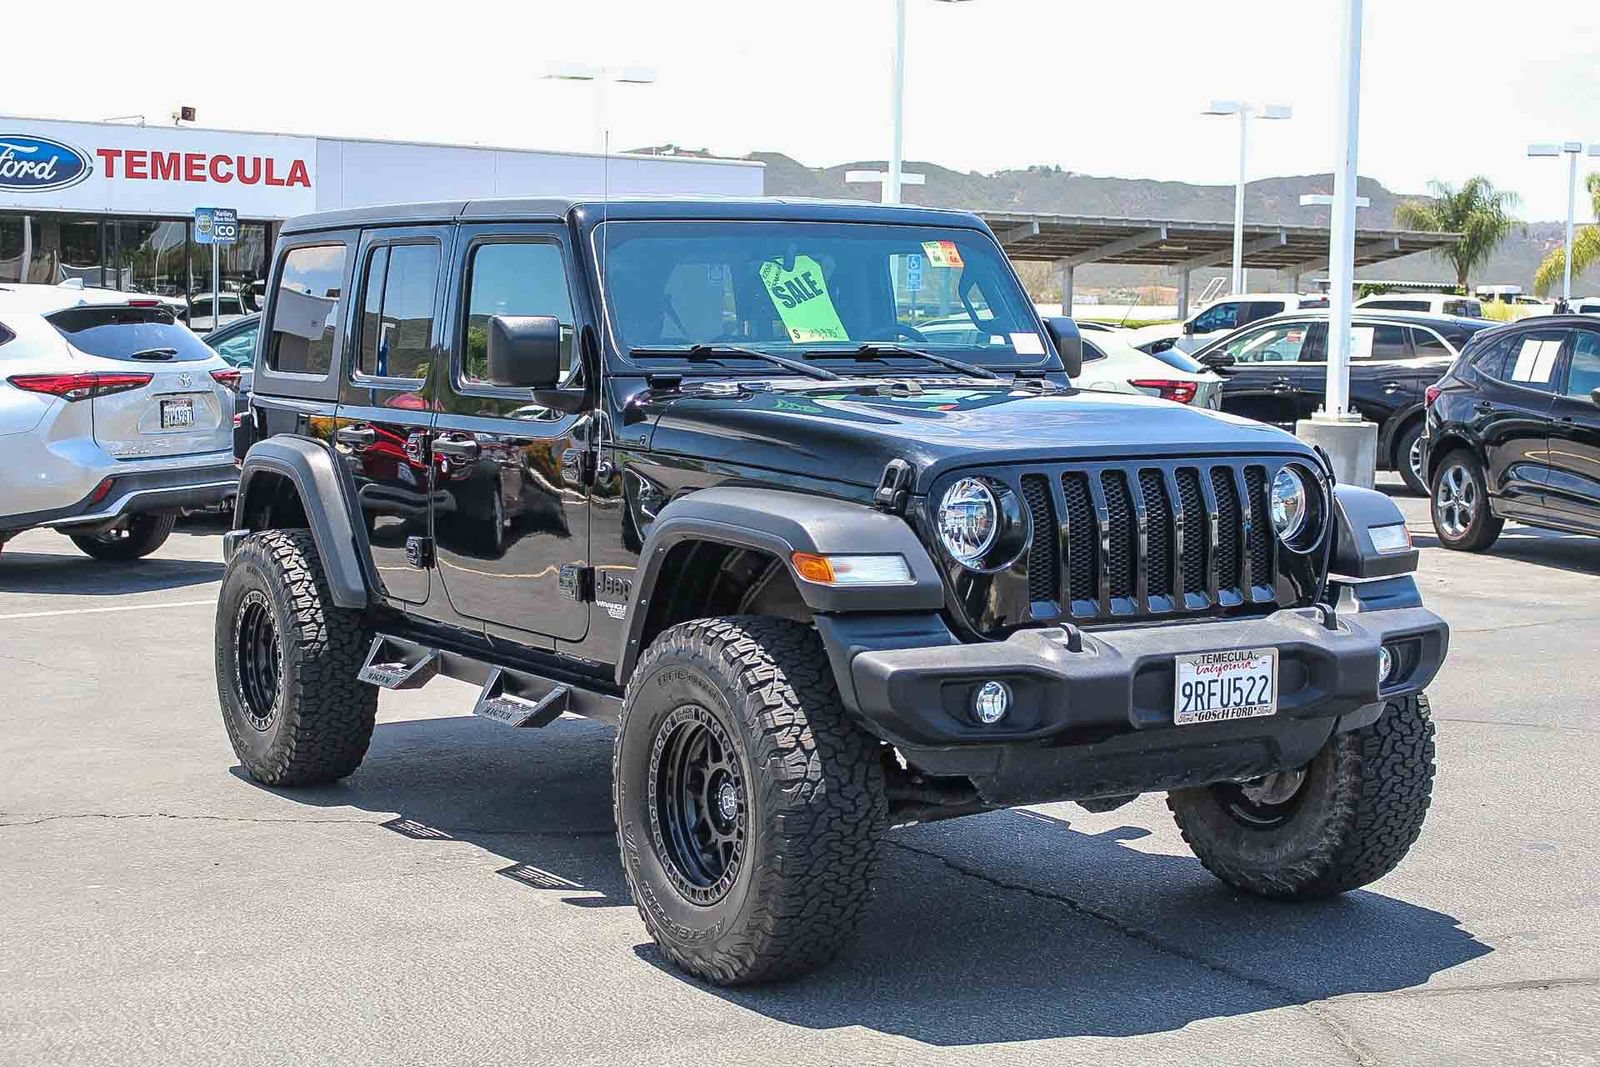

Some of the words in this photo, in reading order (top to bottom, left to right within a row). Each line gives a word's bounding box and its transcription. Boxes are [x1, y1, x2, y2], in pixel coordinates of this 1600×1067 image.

[0, 142, 59, 181] Ford
[96, 148, 312, 188] TEMECULA
[215, 225, 235, 236] ICO
[771, 270, 824, 309] SALE
[597, 570, 633, 601] Jeep
[1196, 660, 1253, 677] California
[1200, 651, 1254, 664] TEMECULA
[1180, 674, 1269, 712] 9RFU522
[1231, 706, 1253, 718] FORD
